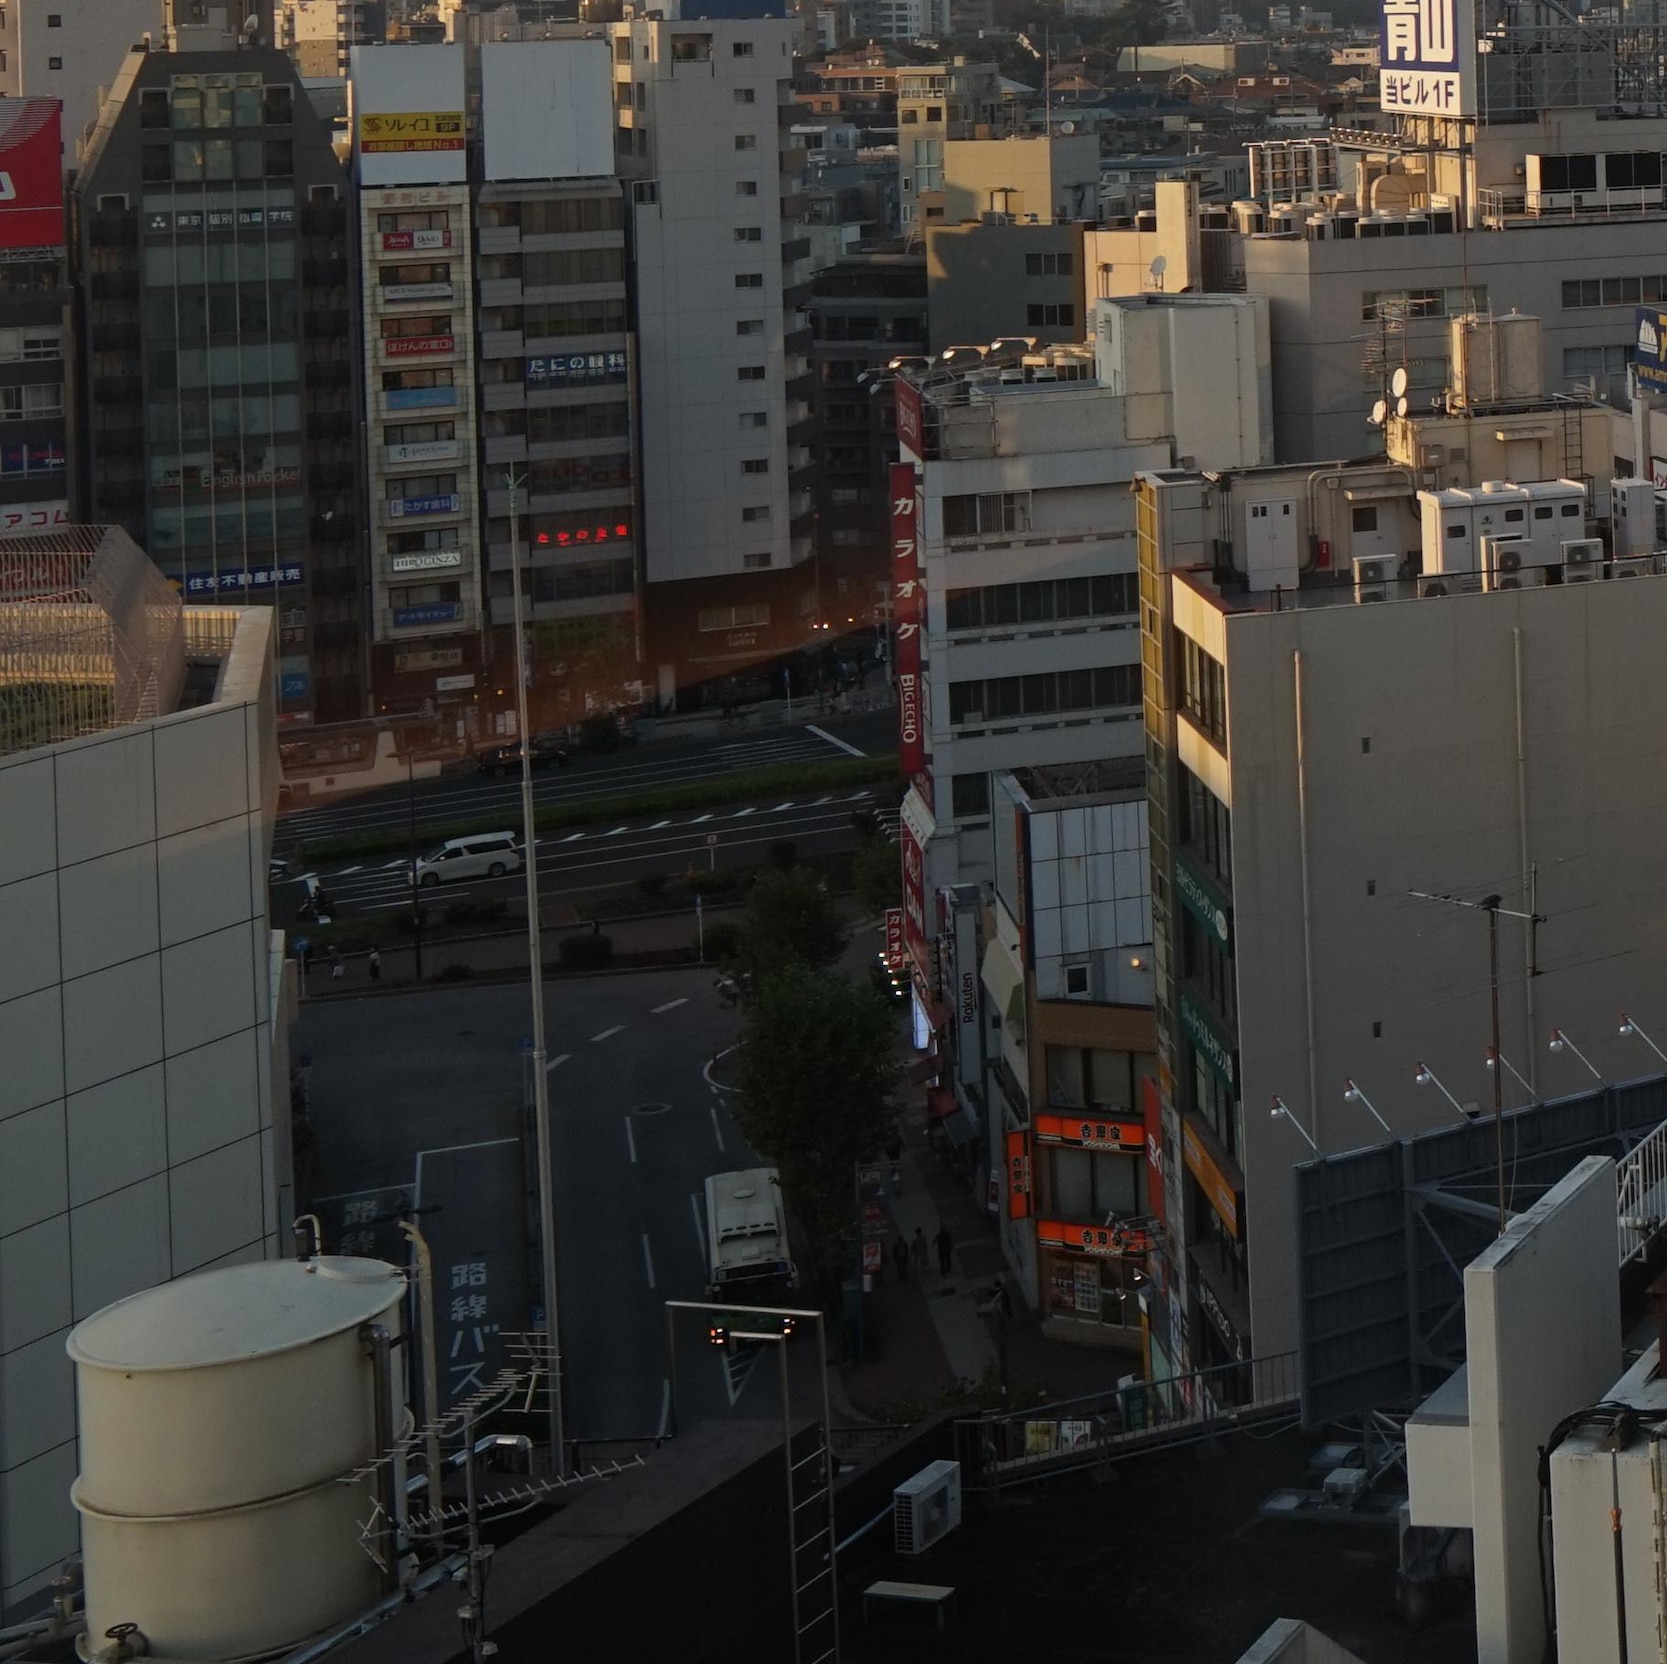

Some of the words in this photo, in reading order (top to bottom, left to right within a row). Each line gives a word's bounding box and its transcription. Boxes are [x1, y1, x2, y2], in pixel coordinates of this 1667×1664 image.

[385, 118, 431, 132] ソレイユ
[528, 352, 625, 373] たにの眼科
[188, 568, 300, 591] 住友不動産販売
[893, 496, 918, 640] カラオケ
[900, 673, 916, 702] BIG
[902, 703, 918, 744] ECHO
[889, 915, 903, 965] カラオケ
[963, 972, 974, 1024] Rakuten
[449, 1262, 500, 1397] 路線バス
